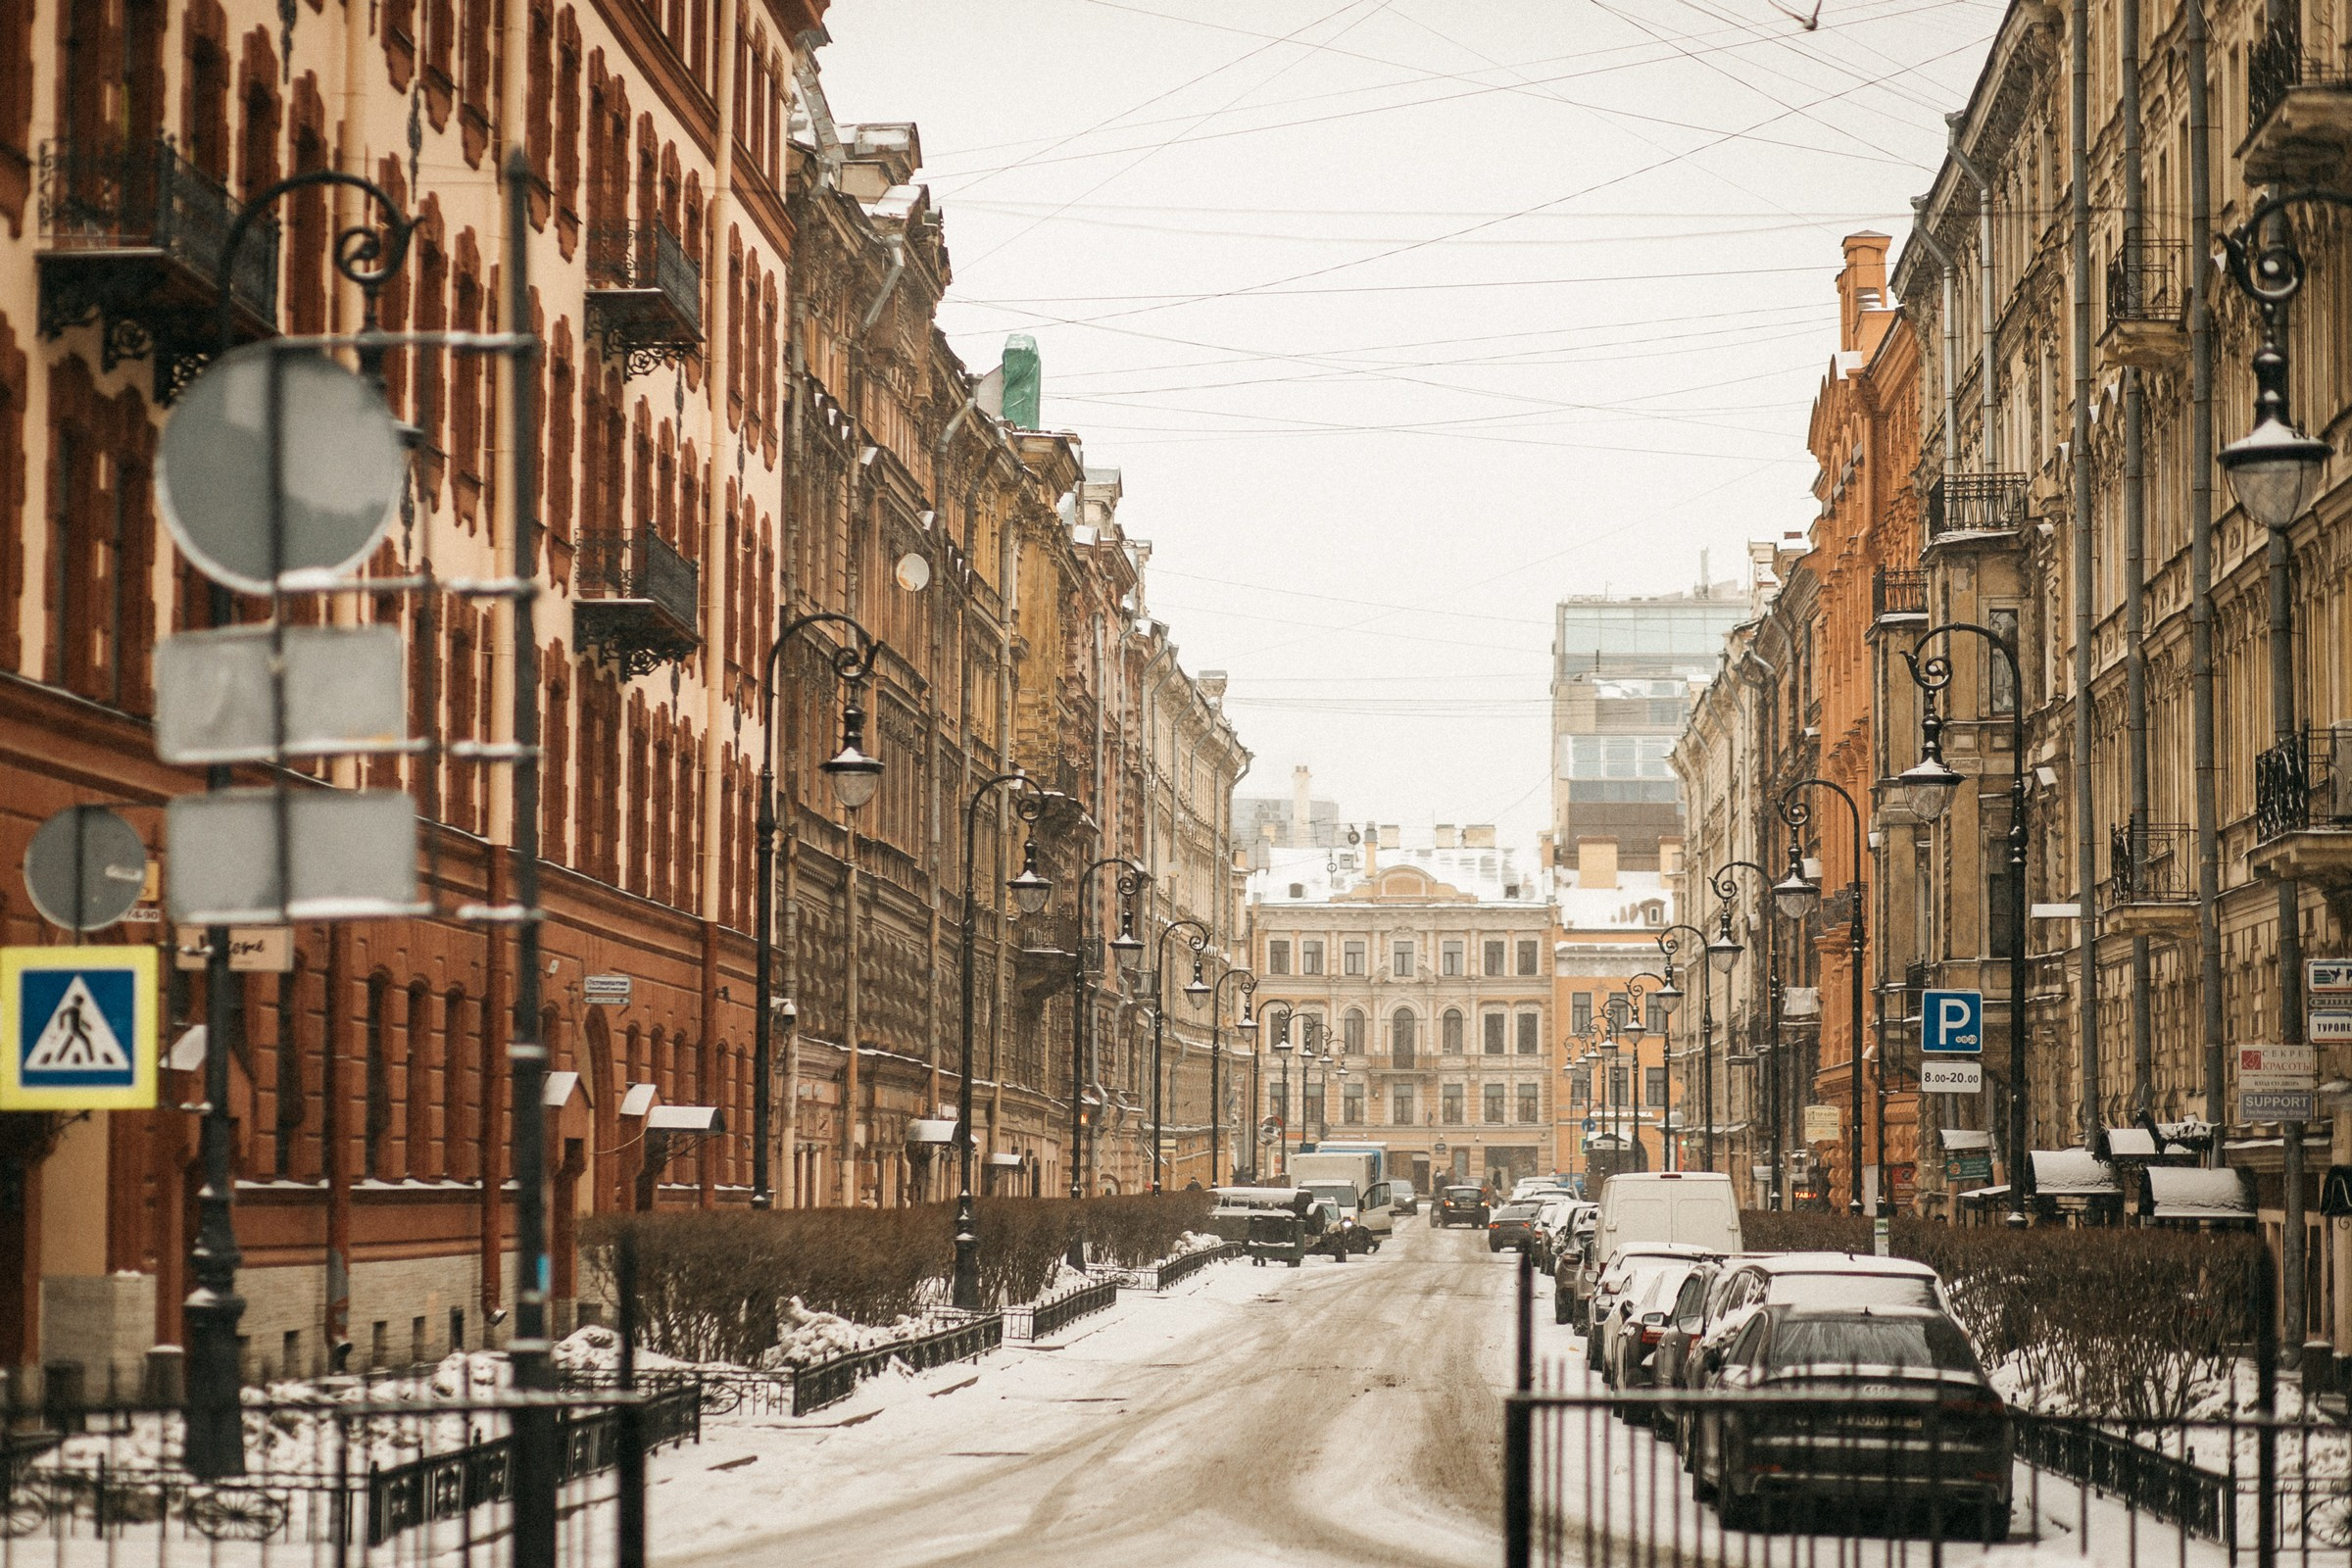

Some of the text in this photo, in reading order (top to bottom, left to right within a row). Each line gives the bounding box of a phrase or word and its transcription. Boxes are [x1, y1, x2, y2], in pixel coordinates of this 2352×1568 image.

[1939, 999, 1971, 1046] P
[2262, 1062, 2312, 1071] КРАСОТЫ
[1924, 1071, 1979, 1083] 8.00-20.00
[2245, 1096, 2309, 1107] SUPPORT
